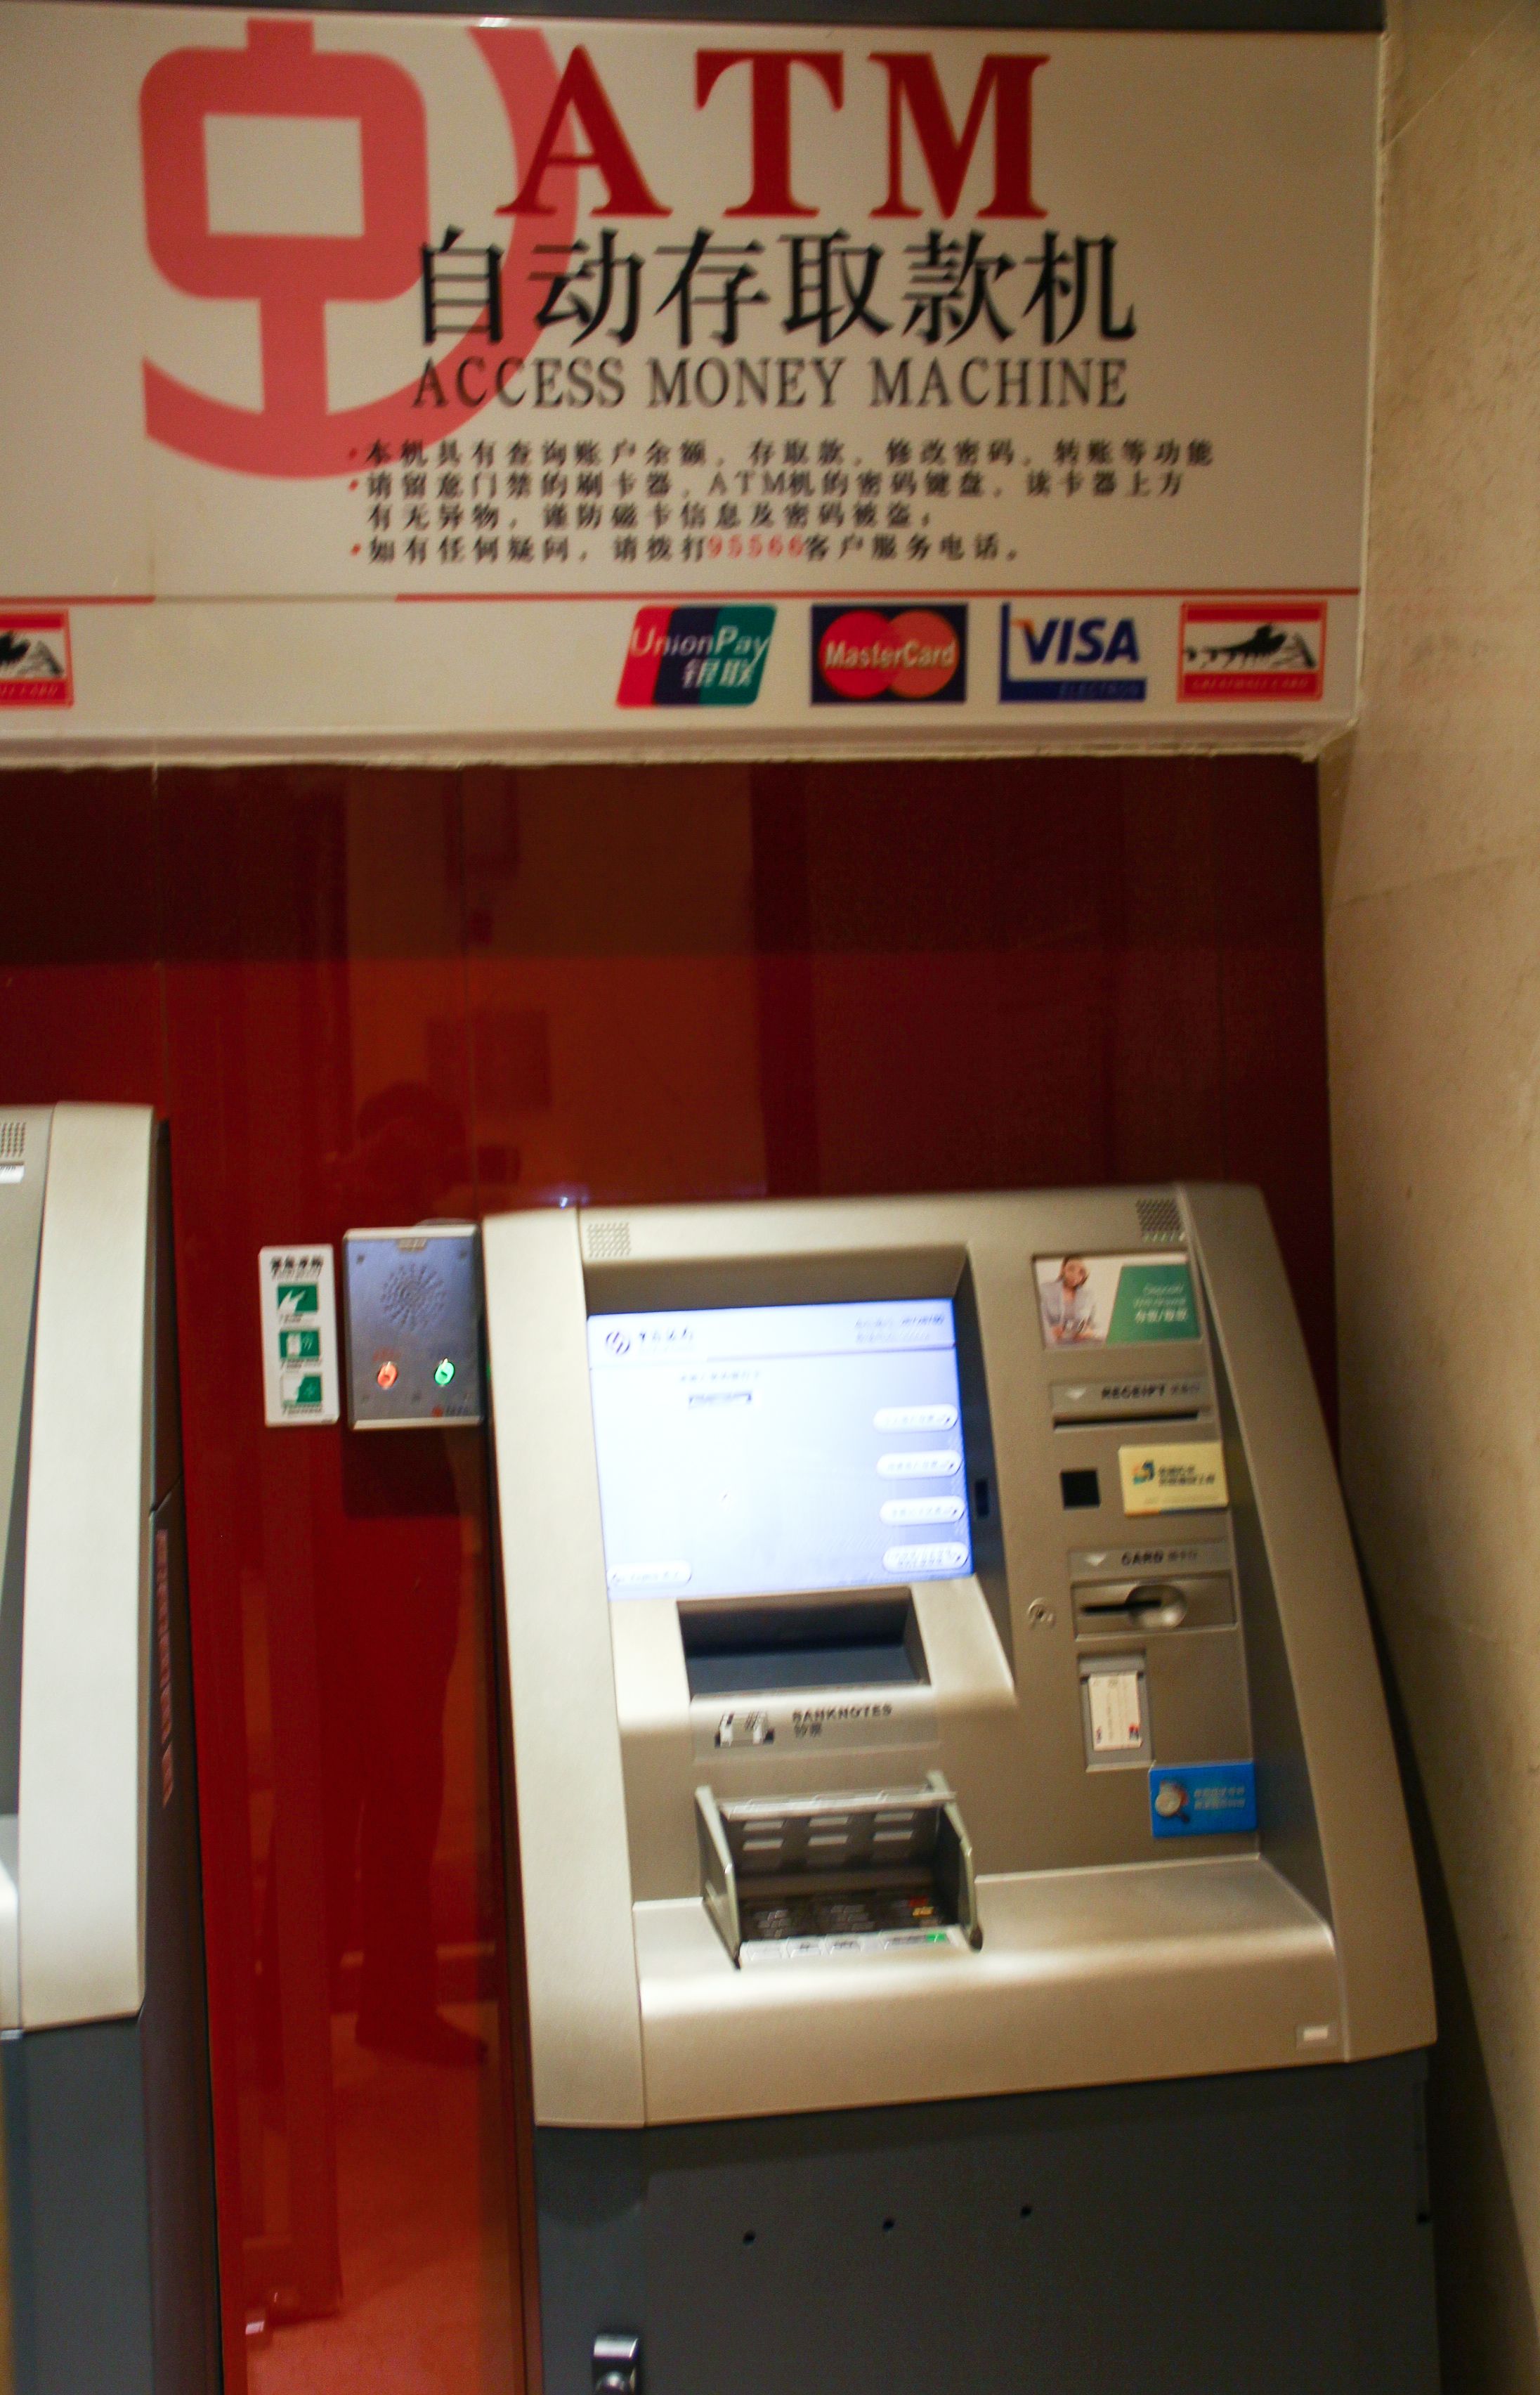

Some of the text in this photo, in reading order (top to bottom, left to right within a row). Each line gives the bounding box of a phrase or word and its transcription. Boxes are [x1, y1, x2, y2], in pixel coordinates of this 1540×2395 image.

[495, 44, 1051, 219] ATM
[420, 225, 1137, 347] 自动存取款机
[411, 356, 1127, 408] ACCESS MONEY MACHINE
[632, 625, 772, 664] UnionPay
[824, 640, 956, 670] MasterCard
[1012, 618, 1140, 666] VISA
[1120, 1550, 1164, 1567] CARD
[792, 1703, 893, 1724] BANKNOTES
